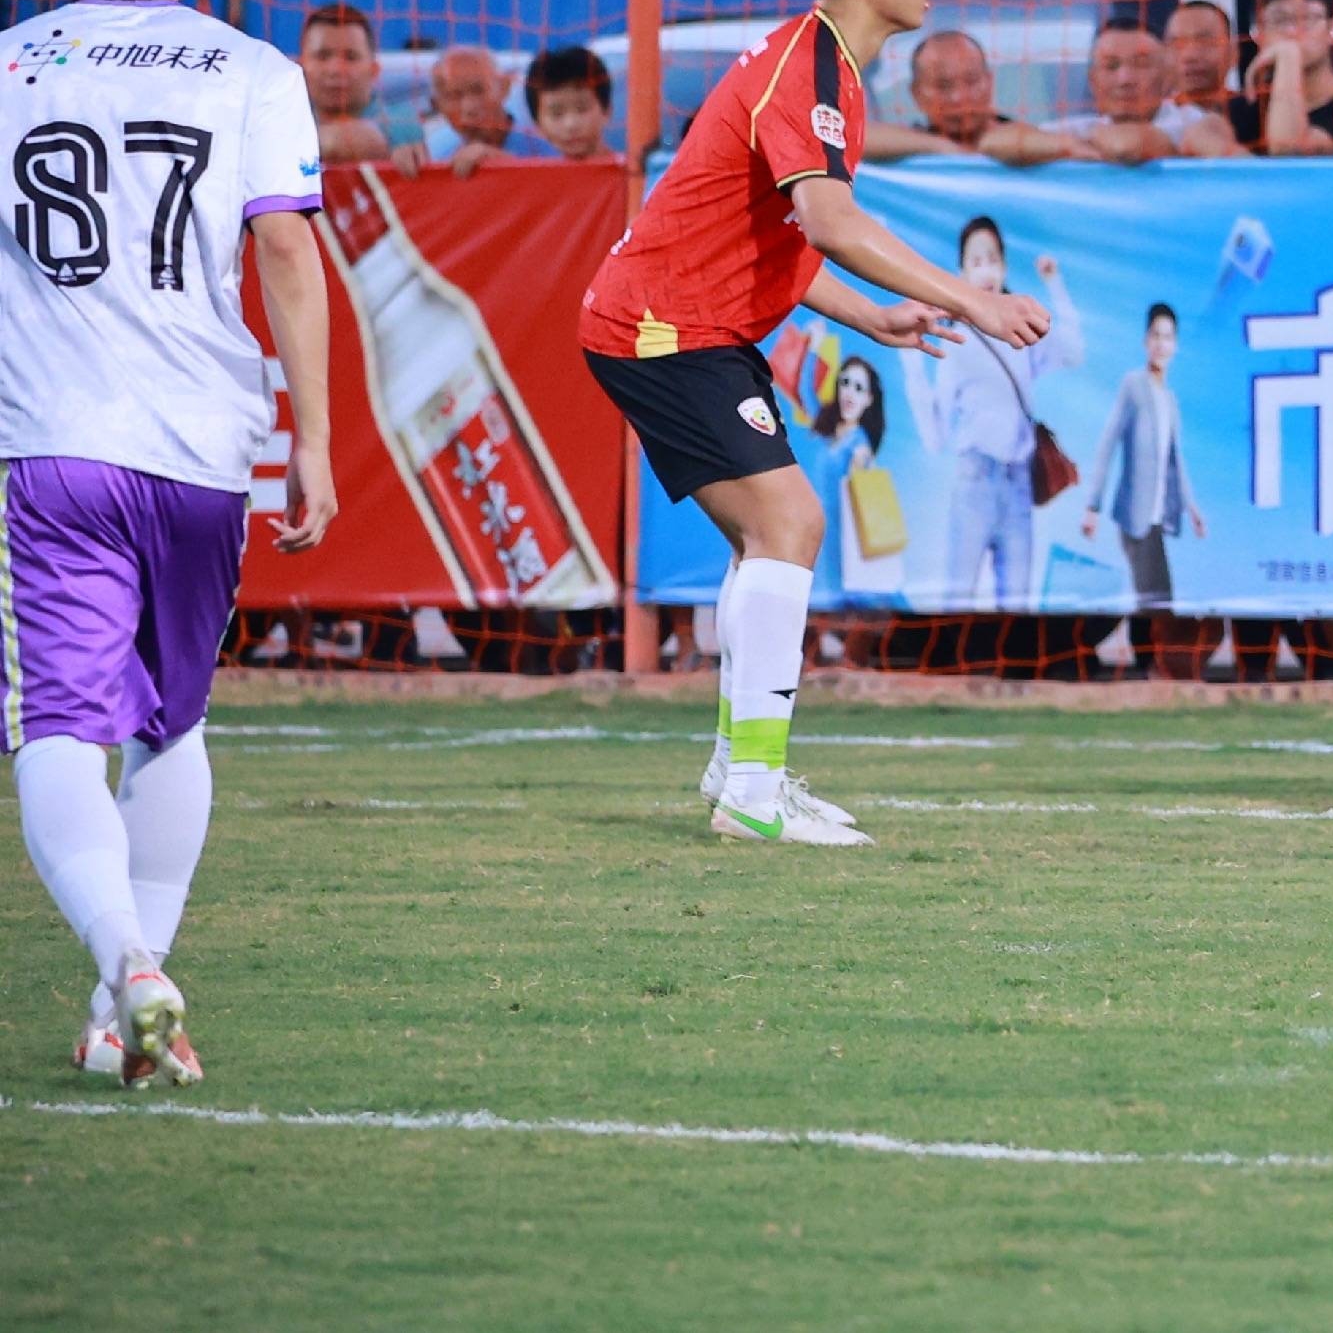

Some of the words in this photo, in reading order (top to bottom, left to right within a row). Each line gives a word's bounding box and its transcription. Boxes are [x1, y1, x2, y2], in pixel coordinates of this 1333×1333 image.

[86, 42, 232, 74] 中旭未来
[13, 120, 214, 292] 87
